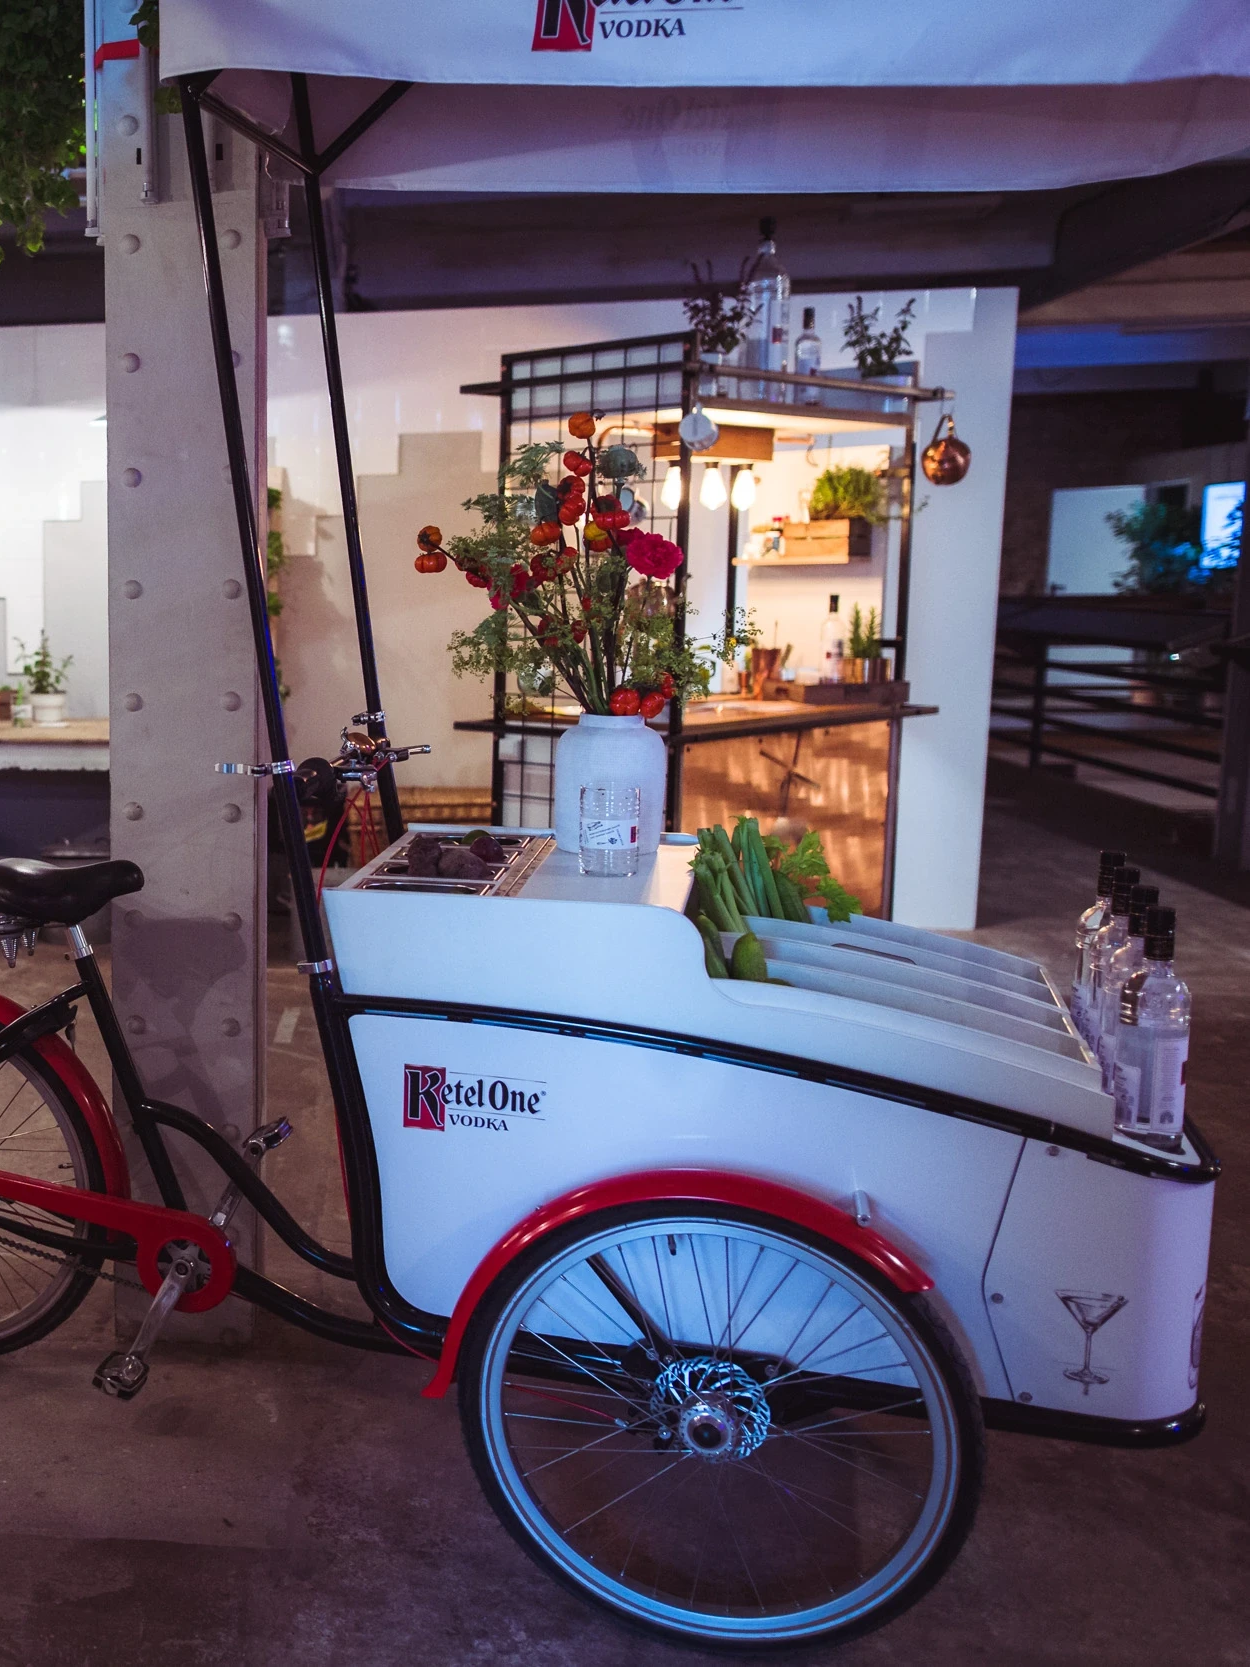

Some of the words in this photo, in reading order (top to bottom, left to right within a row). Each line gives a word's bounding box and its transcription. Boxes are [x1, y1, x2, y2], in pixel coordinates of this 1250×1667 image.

[599, 18, 686, 39] VODKA
[405, 1069, 485, 1128] Ketel
[488, 1080, 541, 1115] One
[448, 1113, 509, 1132] VODKA
